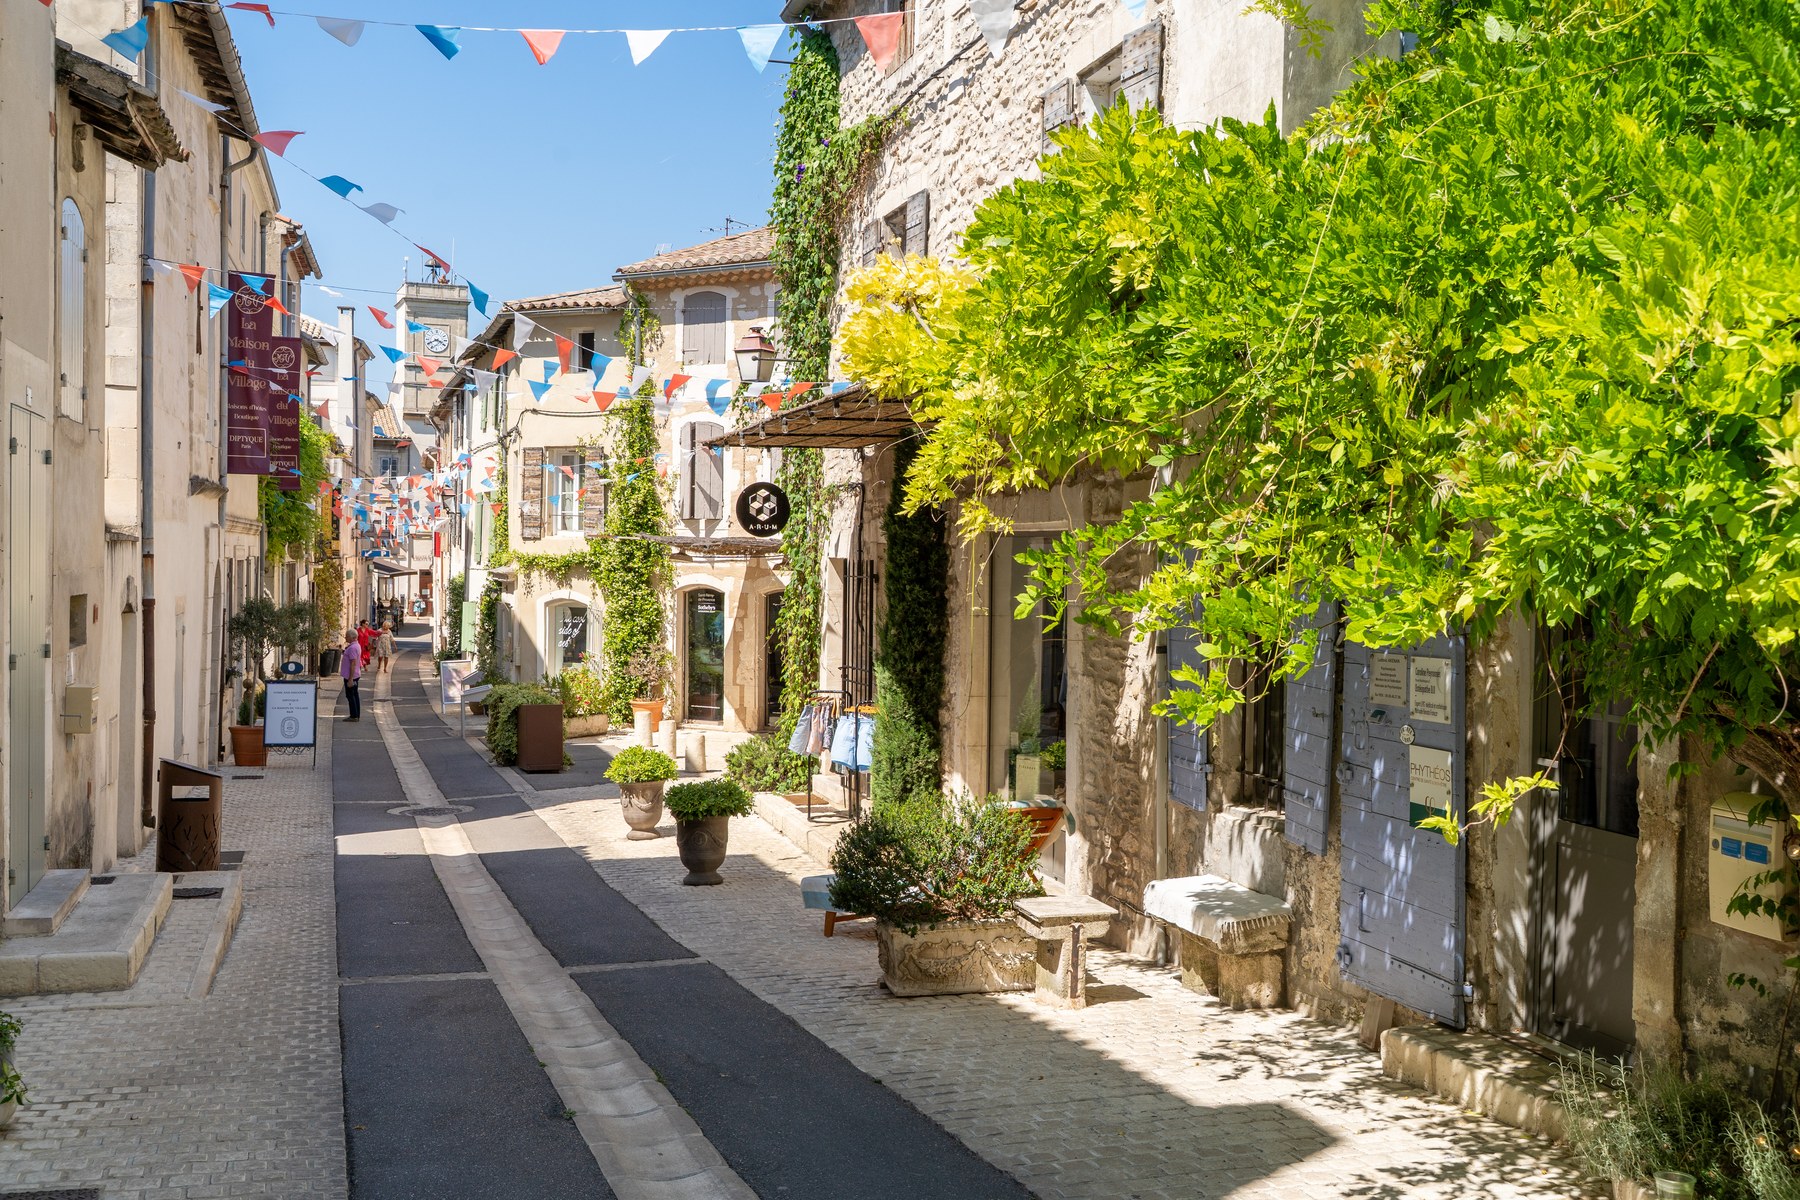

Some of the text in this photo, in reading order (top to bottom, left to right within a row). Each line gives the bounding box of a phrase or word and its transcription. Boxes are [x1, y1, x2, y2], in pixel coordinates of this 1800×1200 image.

[241, 317, 256, 330] La
[228, 336, 269, 350] Maison
[228, 375, 267, 391] Village
[276, 401, 289, 410] du
[233, 413, 260, 421] Boutique
[268, 415, 298, 427] Village
[229, 435, 264, 444] DIPTYQUE
[1410, 763, 1451, 783] PHYTHÉOS
